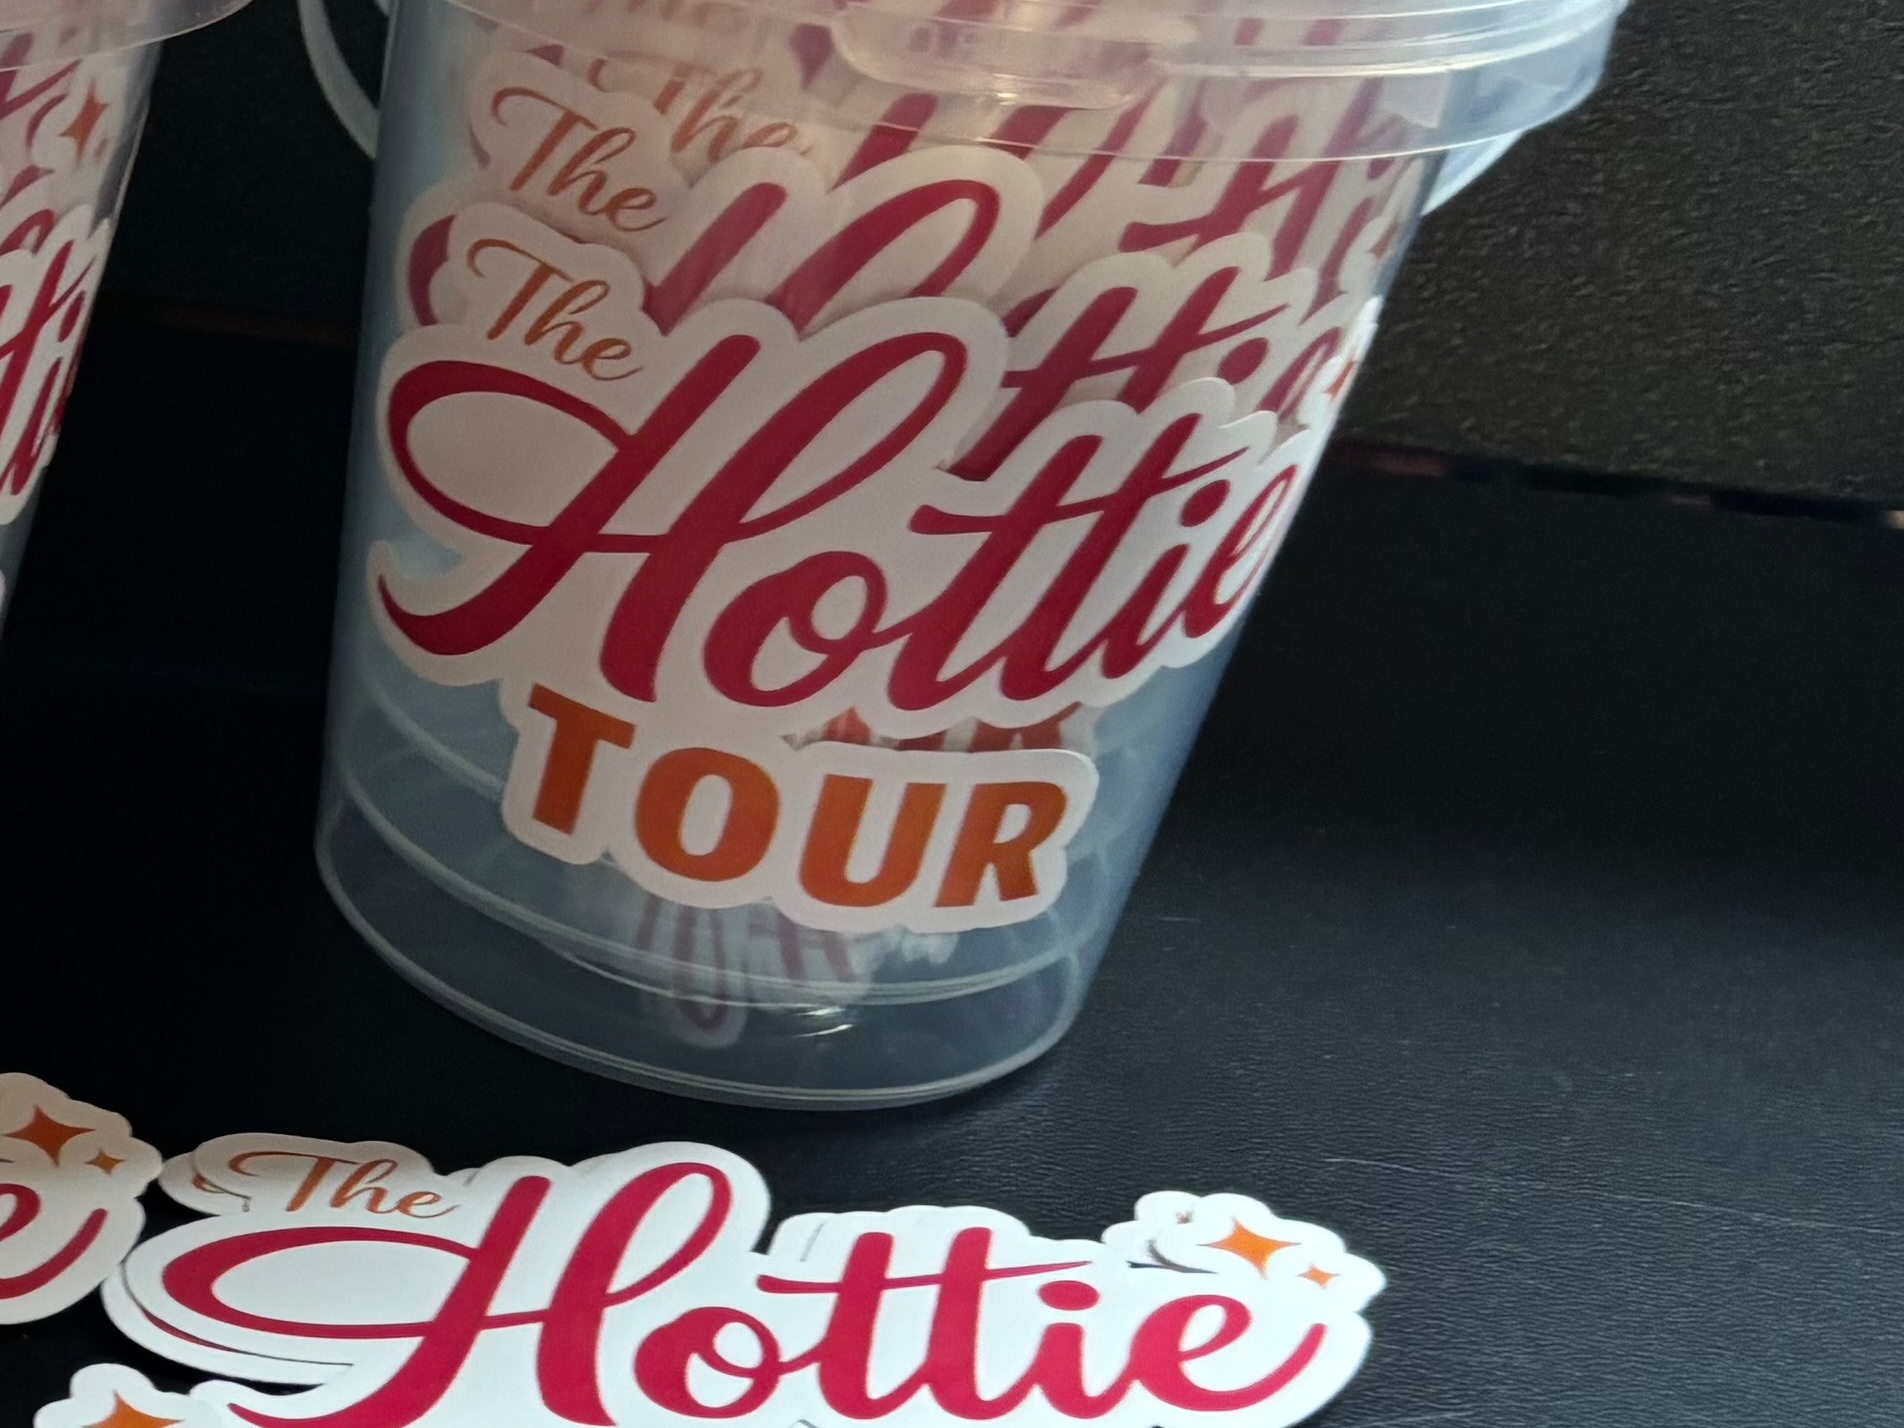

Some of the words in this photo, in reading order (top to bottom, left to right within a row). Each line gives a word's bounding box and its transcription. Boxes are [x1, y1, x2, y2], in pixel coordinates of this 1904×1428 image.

[490, 84, 670, 233] The
[465, 236, 644, 382] The
[378, 331, 1298, 711] Hottie
[522, 683, 1069, 909] TOUR
[228, 1149, 457, 1217] The
